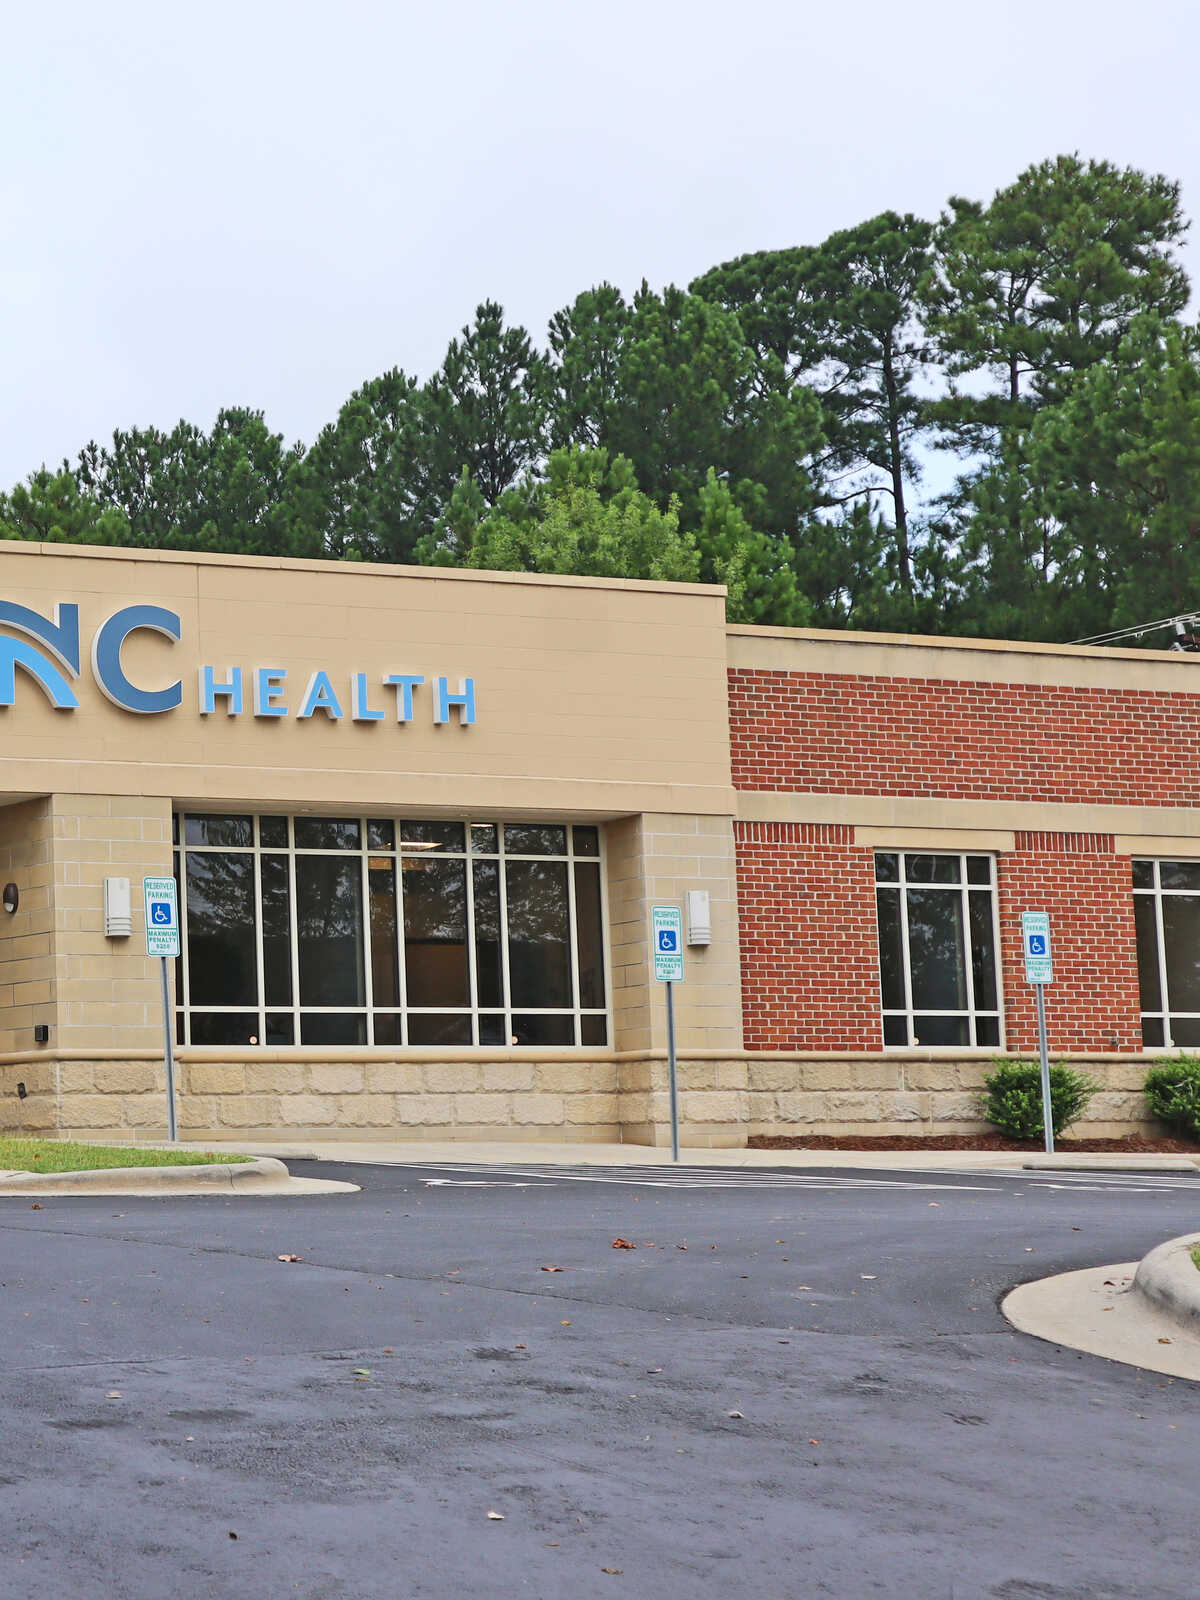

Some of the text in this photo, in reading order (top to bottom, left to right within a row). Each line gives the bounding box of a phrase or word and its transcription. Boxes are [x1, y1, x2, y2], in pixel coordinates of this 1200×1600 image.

[198, 665, 476, 725] HEALTH
[145, 881, 174, 890] RESERVED
[147, 891, 173, 899] PARKING
